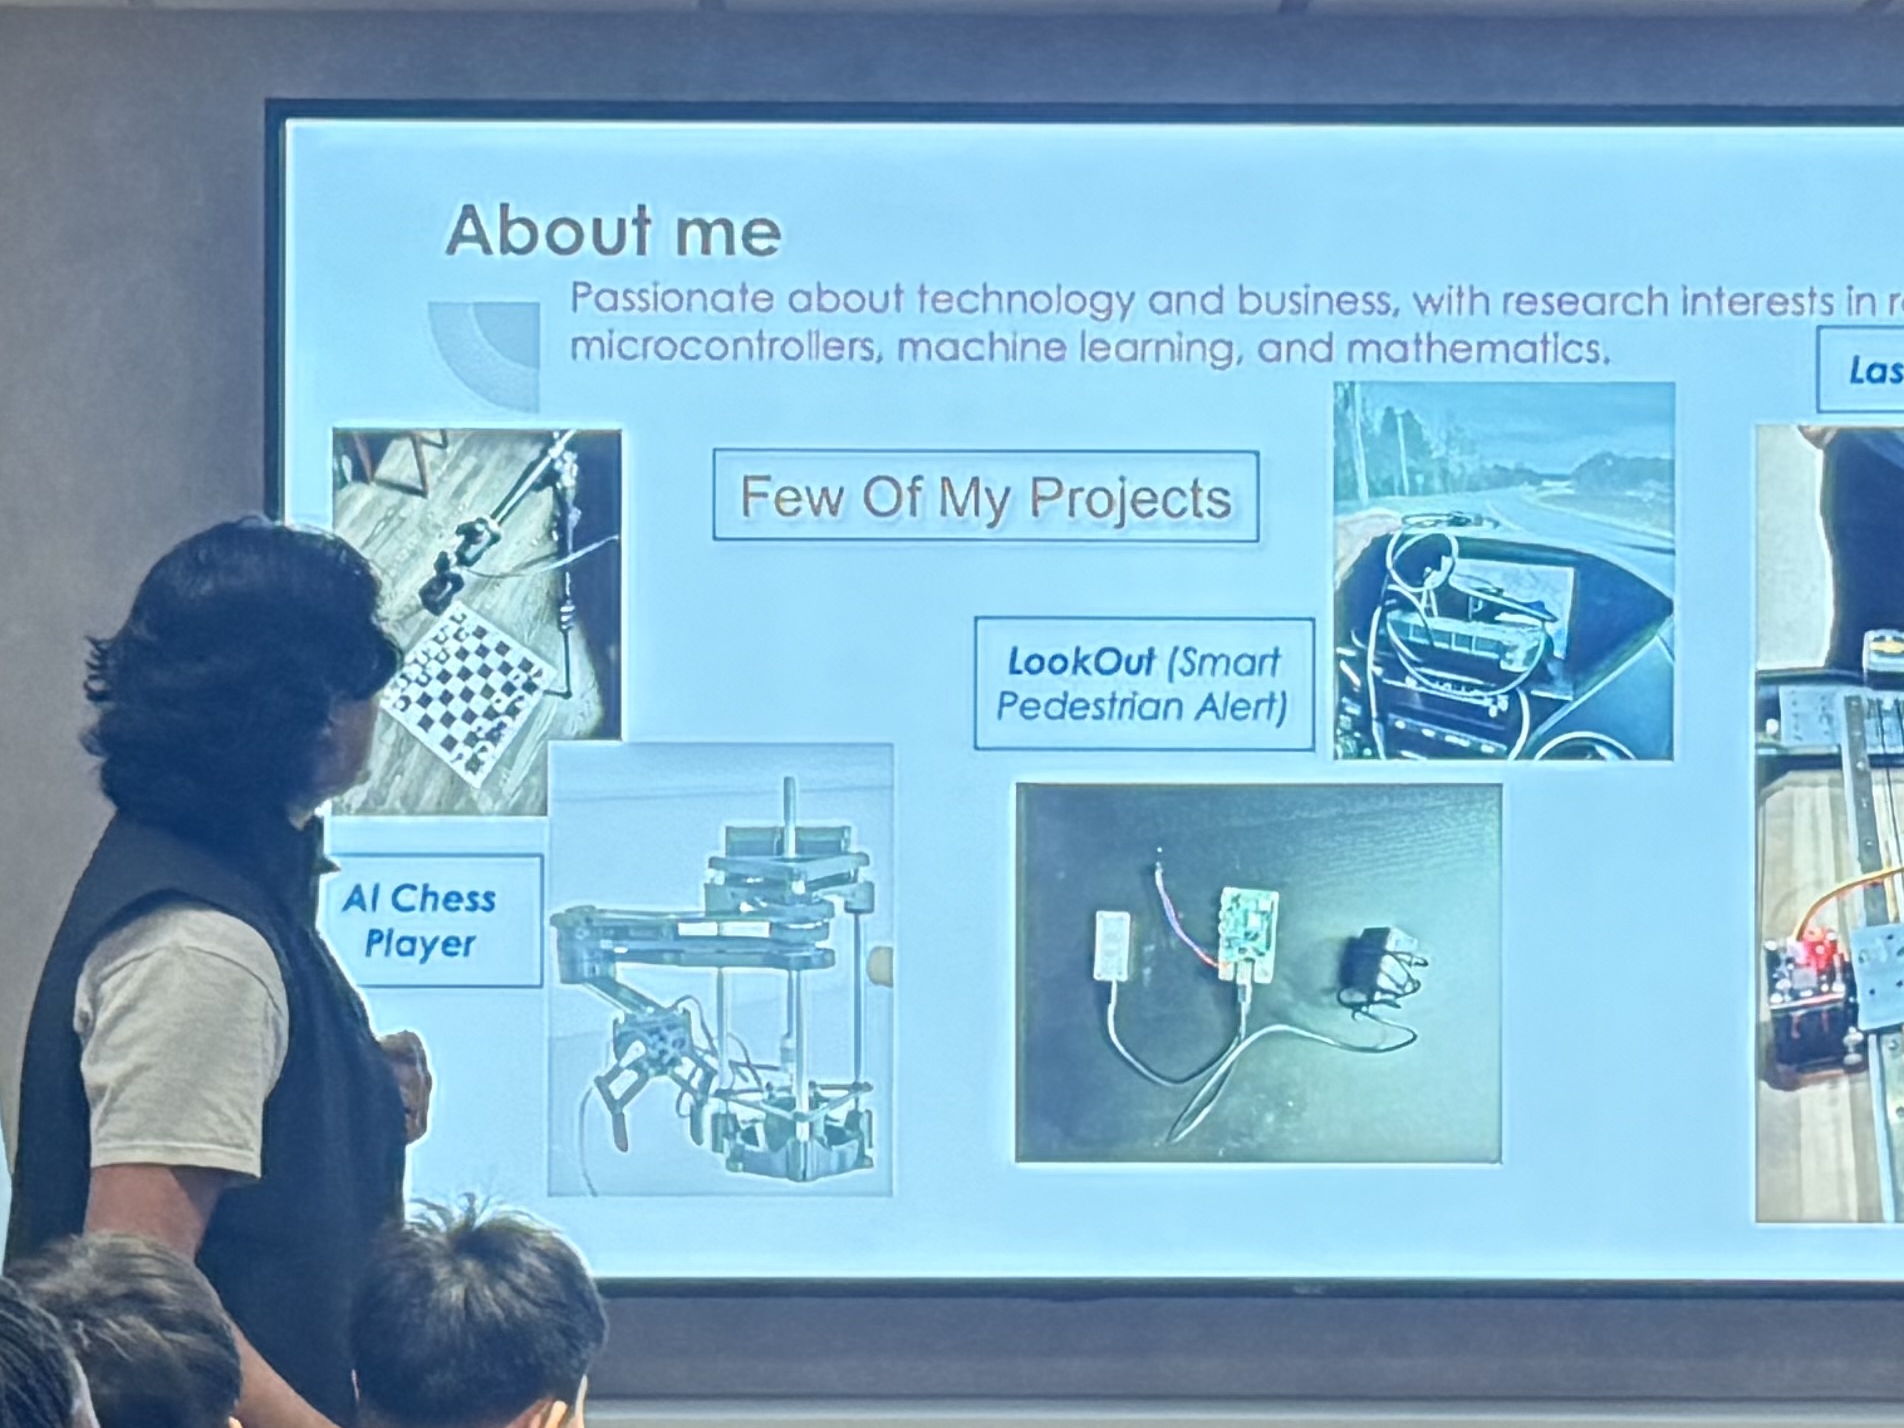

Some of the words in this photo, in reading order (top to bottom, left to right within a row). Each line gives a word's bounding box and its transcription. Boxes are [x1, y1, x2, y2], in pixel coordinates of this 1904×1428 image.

[445, 202, 651, 256] About
[678, 218, 781, 256] me
[572, 280, 773, 313] Passionate
[789, 281, 903, 313] about
[919, 282, 1135, 322] technology
[1149, 284, 1223, 315] and
[1239, 283, 1400, 318] business,
[1413, 284, 1489, 316] with
[1503, 284, 1667, 316] research
[1682, 284, 1834, 318] interests
[1848, 284, 1876, 317] in
[571, 328, 883, 364] microcontrollers,
[898, 330, 1066, 362] machine
[1081, 329, 1243, 370] learning,
[1258, 331, 1333, 363] and
[1348, 331, 1610, 365] mathematics.
[743, 475, 844, 517] Few
[864, 474, 924, 517] Of
[940, 476, 1011, 529] My
[1032, 475, 1231, 529] Projects
[1009, 646, 1156, 676] LookOut
[1168, 646, 1281, 679] (Smart
[997, 691, 1183, 720] Pedestrian
[1194, 690, 1287, 728] Alert)
[341, 883, 380, 912] AI
[392, 883, 496, 913] Chess
[365, 928, 476, 964] Player
